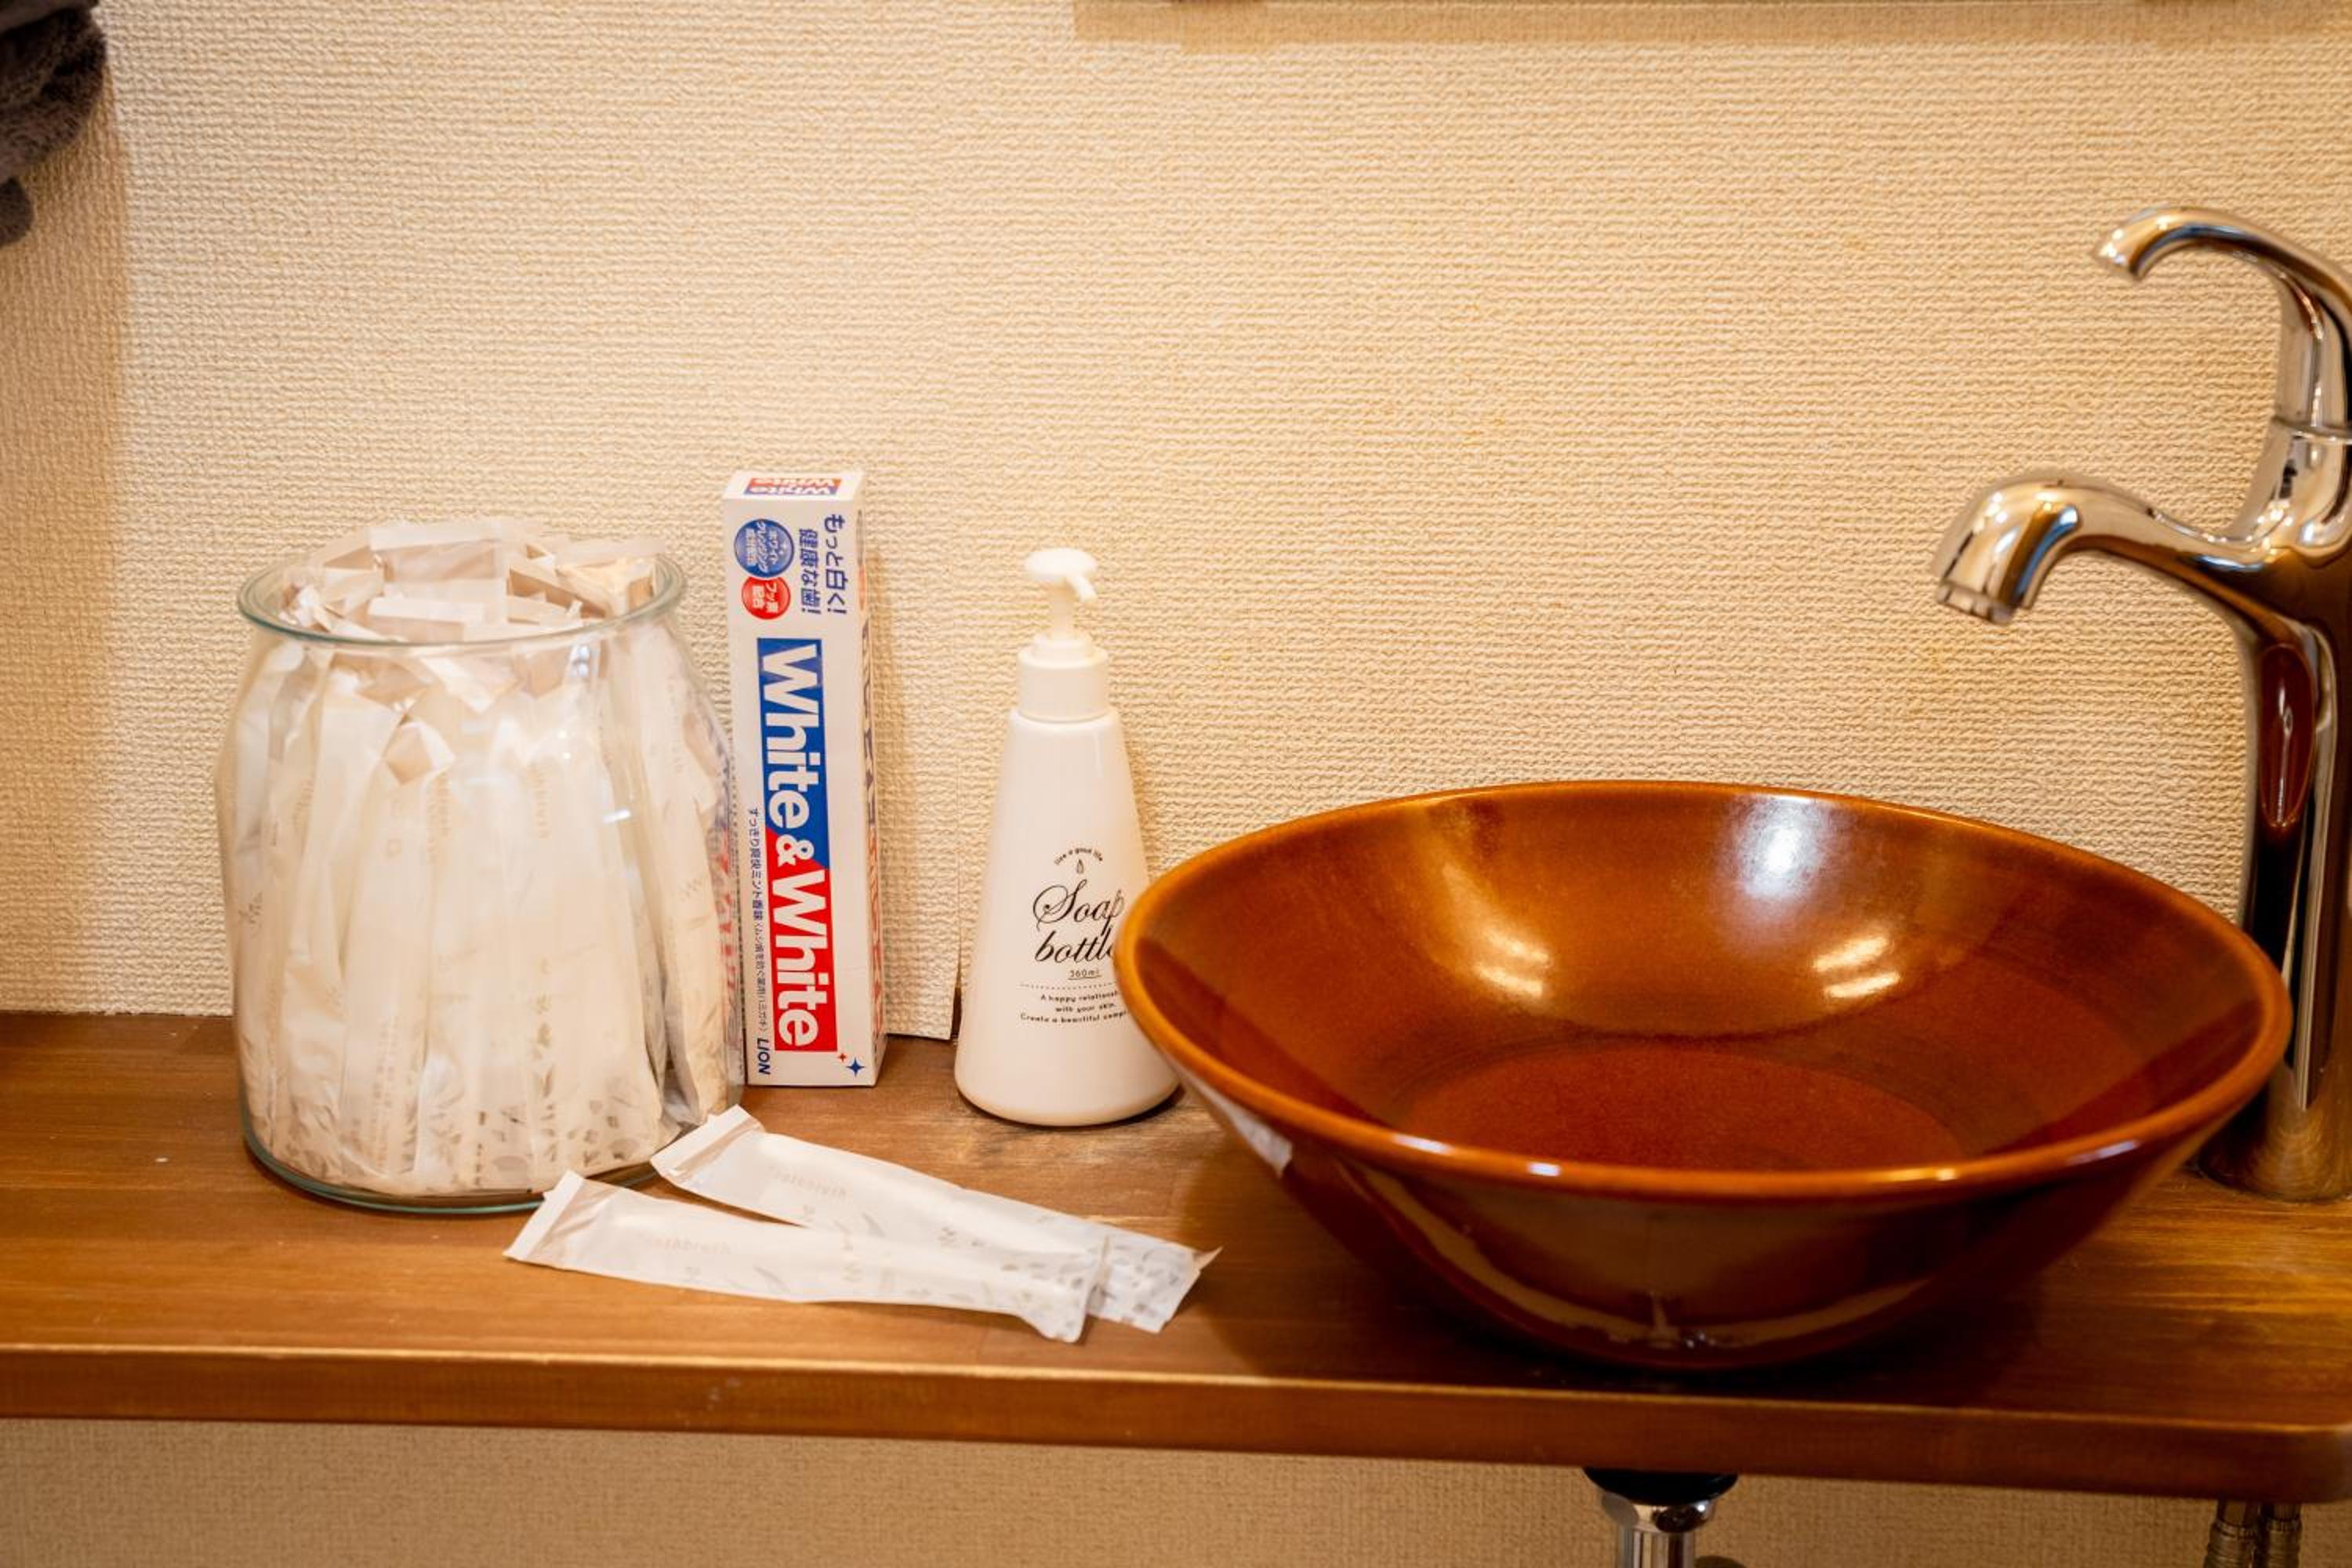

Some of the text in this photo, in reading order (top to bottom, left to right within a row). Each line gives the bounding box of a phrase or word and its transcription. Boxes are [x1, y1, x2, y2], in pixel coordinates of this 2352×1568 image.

[824, 514, 848, 614] もっと白く!
[762, 644, 821, 828] White
[771, 868, 828, 1047] White
[1033, 879, 1125, 937] Soap
[757, 1037, 771, 1076] LION
